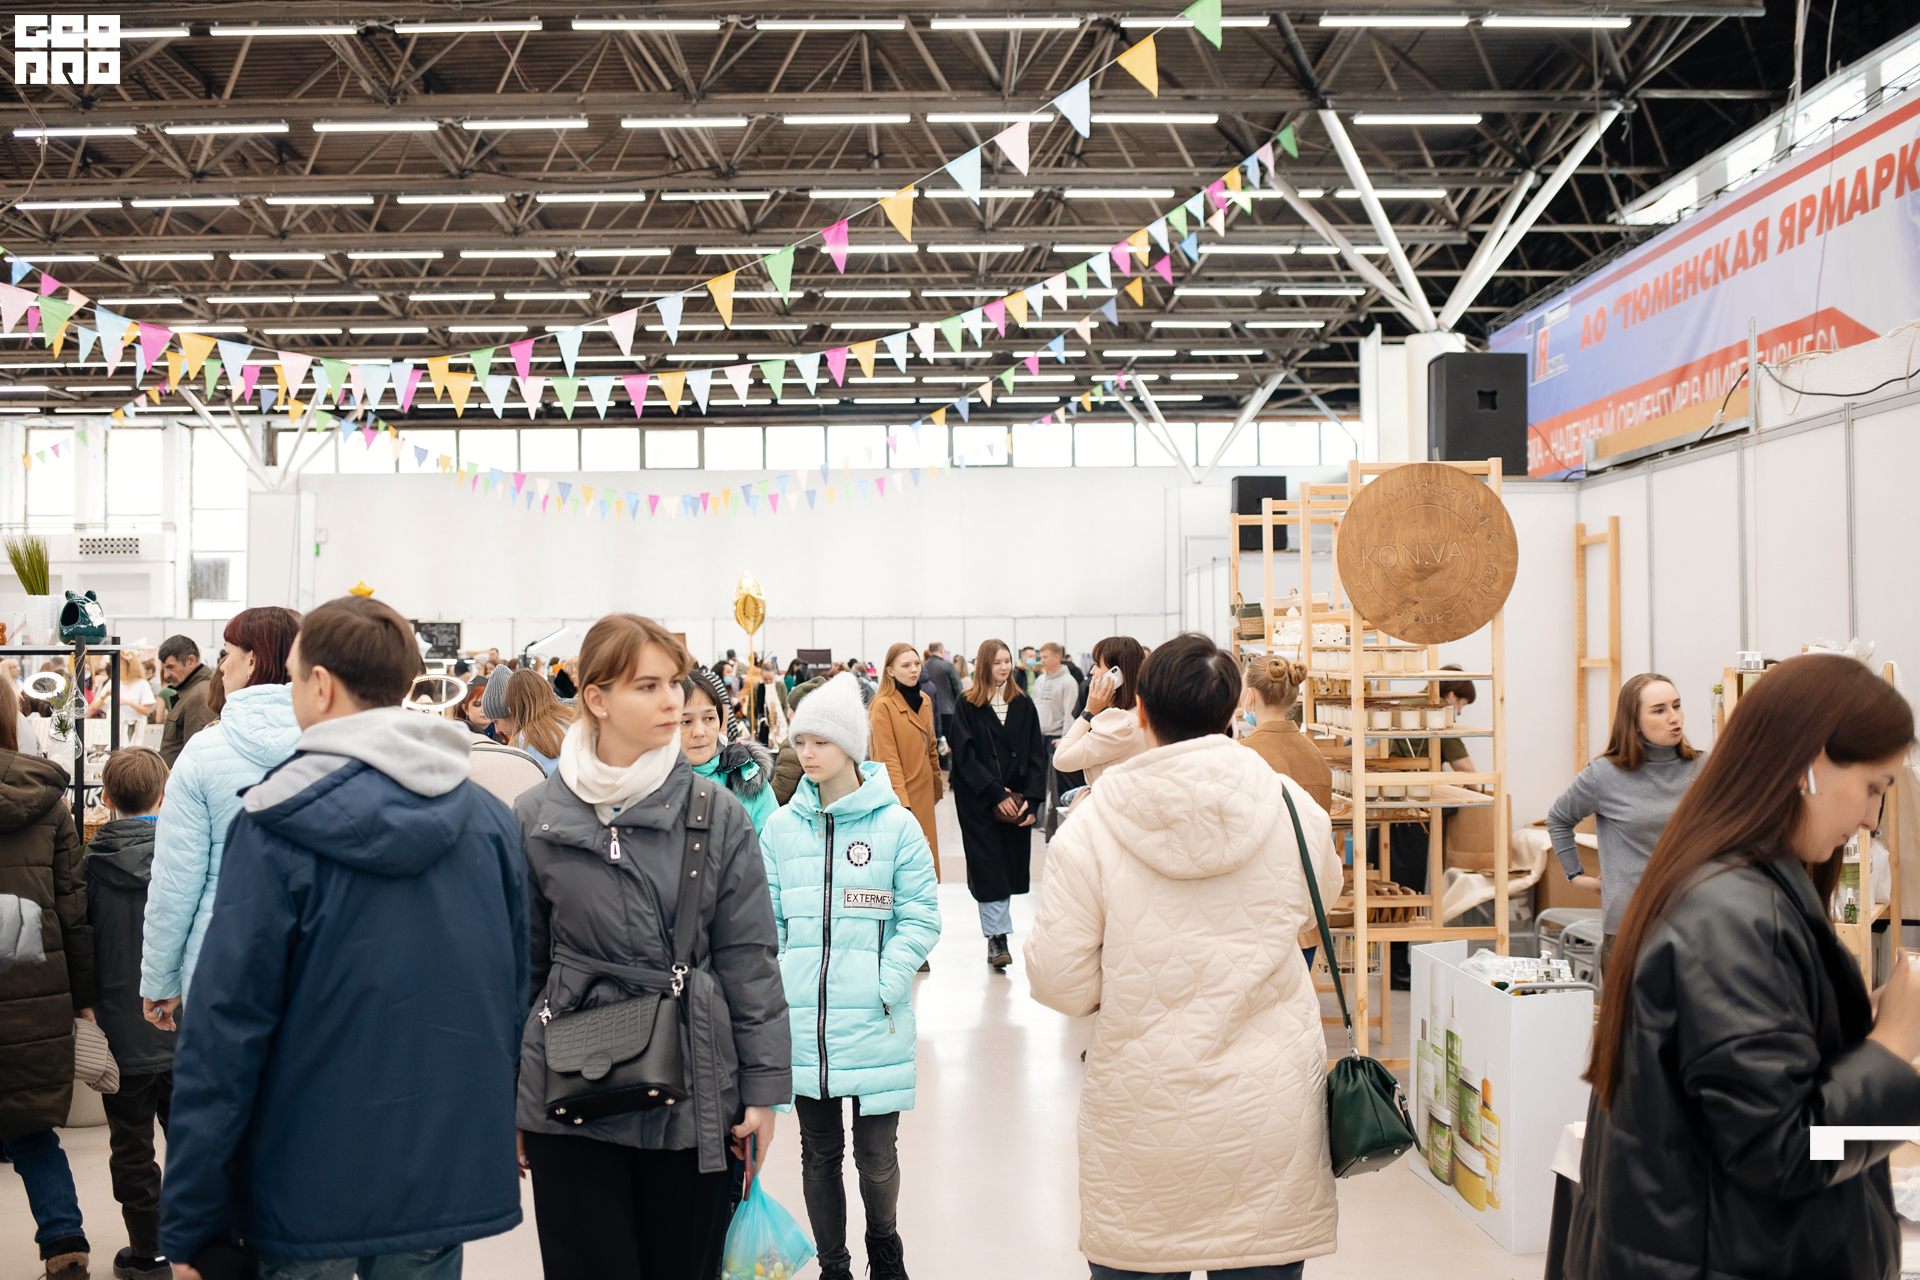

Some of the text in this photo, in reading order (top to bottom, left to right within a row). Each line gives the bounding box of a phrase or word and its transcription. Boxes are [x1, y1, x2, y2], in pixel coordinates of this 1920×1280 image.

[1579, 306, 1608, 352] АО
[1776, 137, 1920, 255] ЯРМАРК
[1617, 380, 1689, 432] ОРИЕНТИР
[1691, 376, 1700, 406] В
[1705, 357, 1748, 401] МИРЕ
[1383, 478, 1493, 526] handcrafted
[1361, 541, 1465, 568] KON.VA
[1485, 531, 1501, 546] &
[1462, 553, 1500, 618] natural
